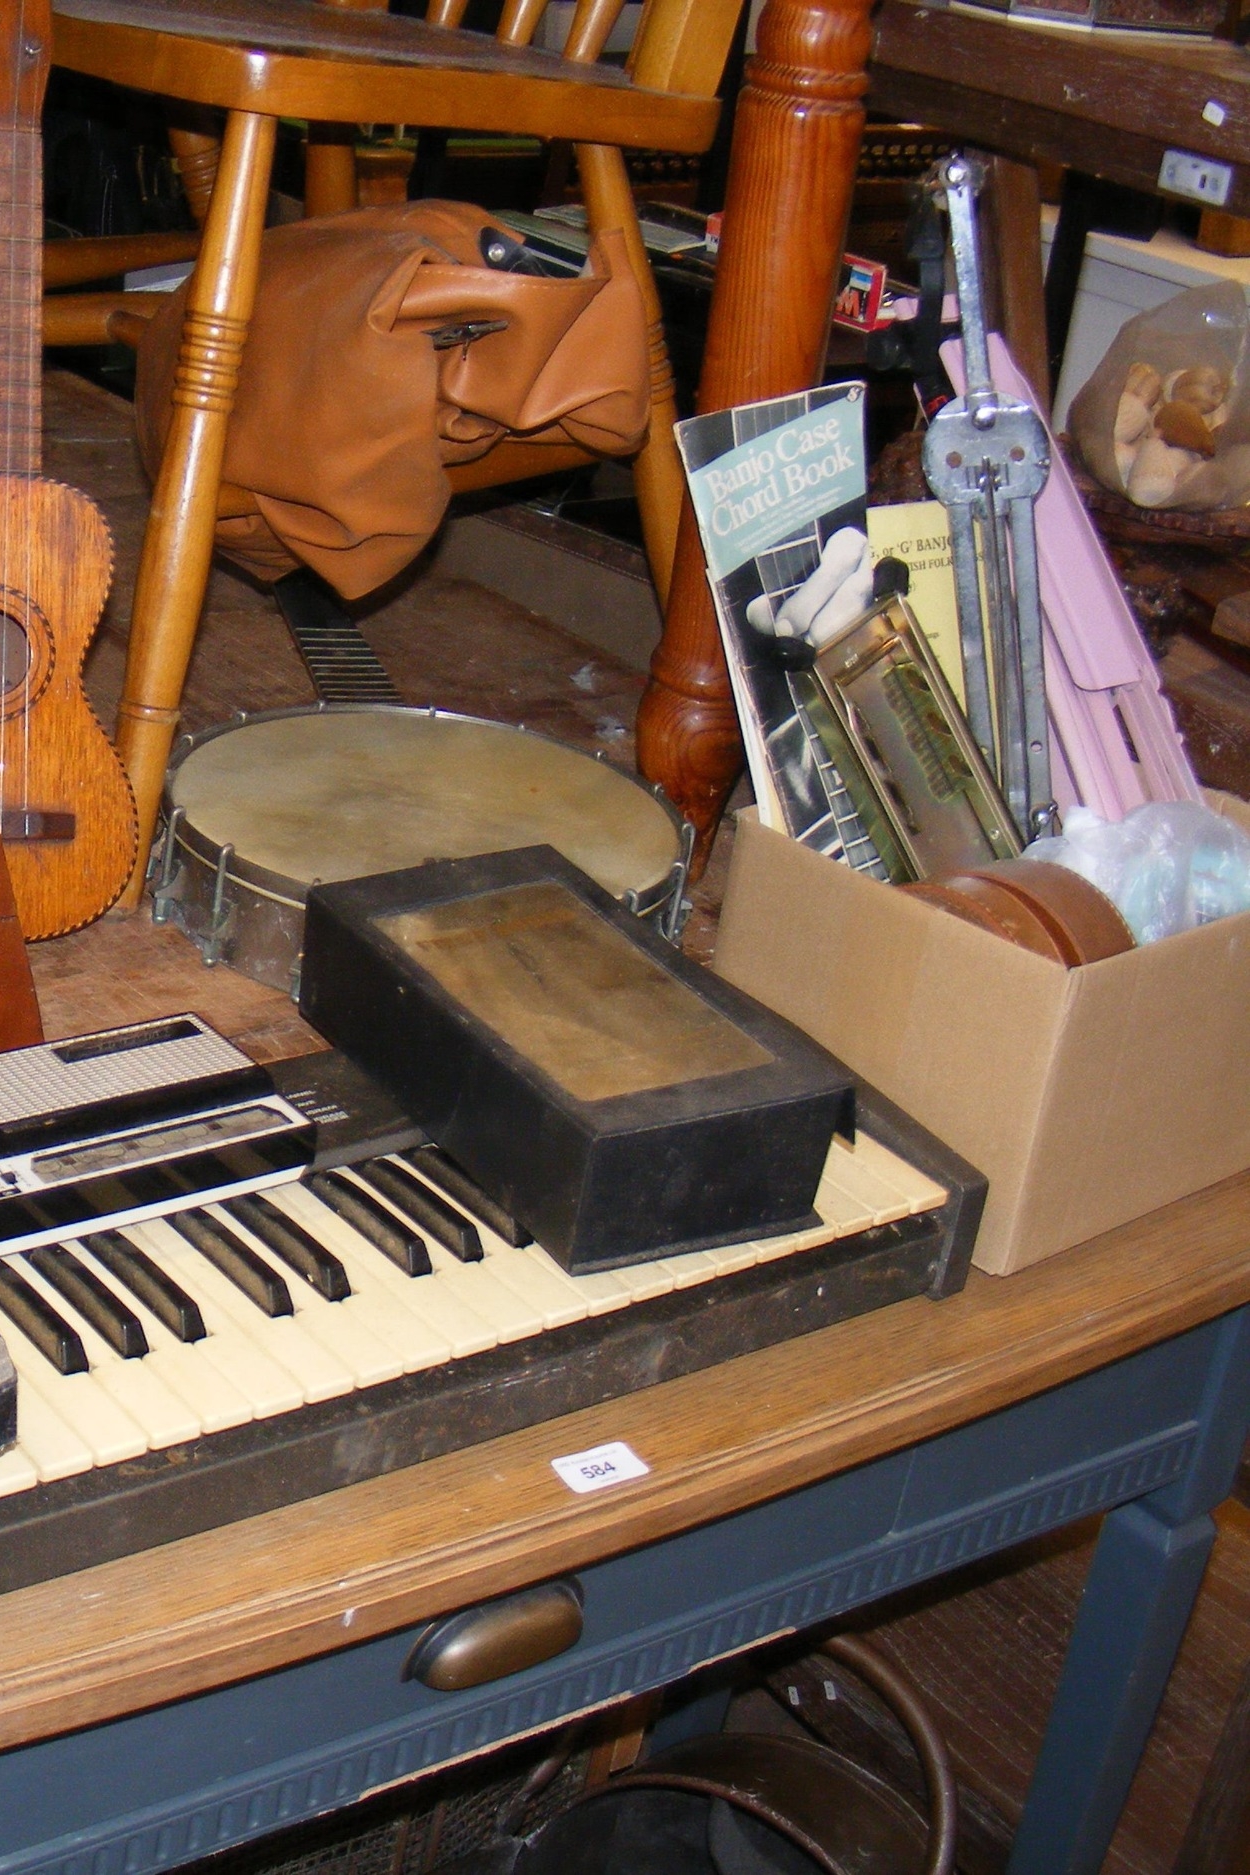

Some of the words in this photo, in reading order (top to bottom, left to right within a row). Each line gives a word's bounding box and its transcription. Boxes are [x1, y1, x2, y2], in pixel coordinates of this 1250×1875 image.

[703, 448, 775, 504] Banjo
[775, 417, 841, 462] Case
[711, 473, 783, 537] Chord
[780, 441, 855, 498] Book
[579, 1461, 617, 1479] 584
